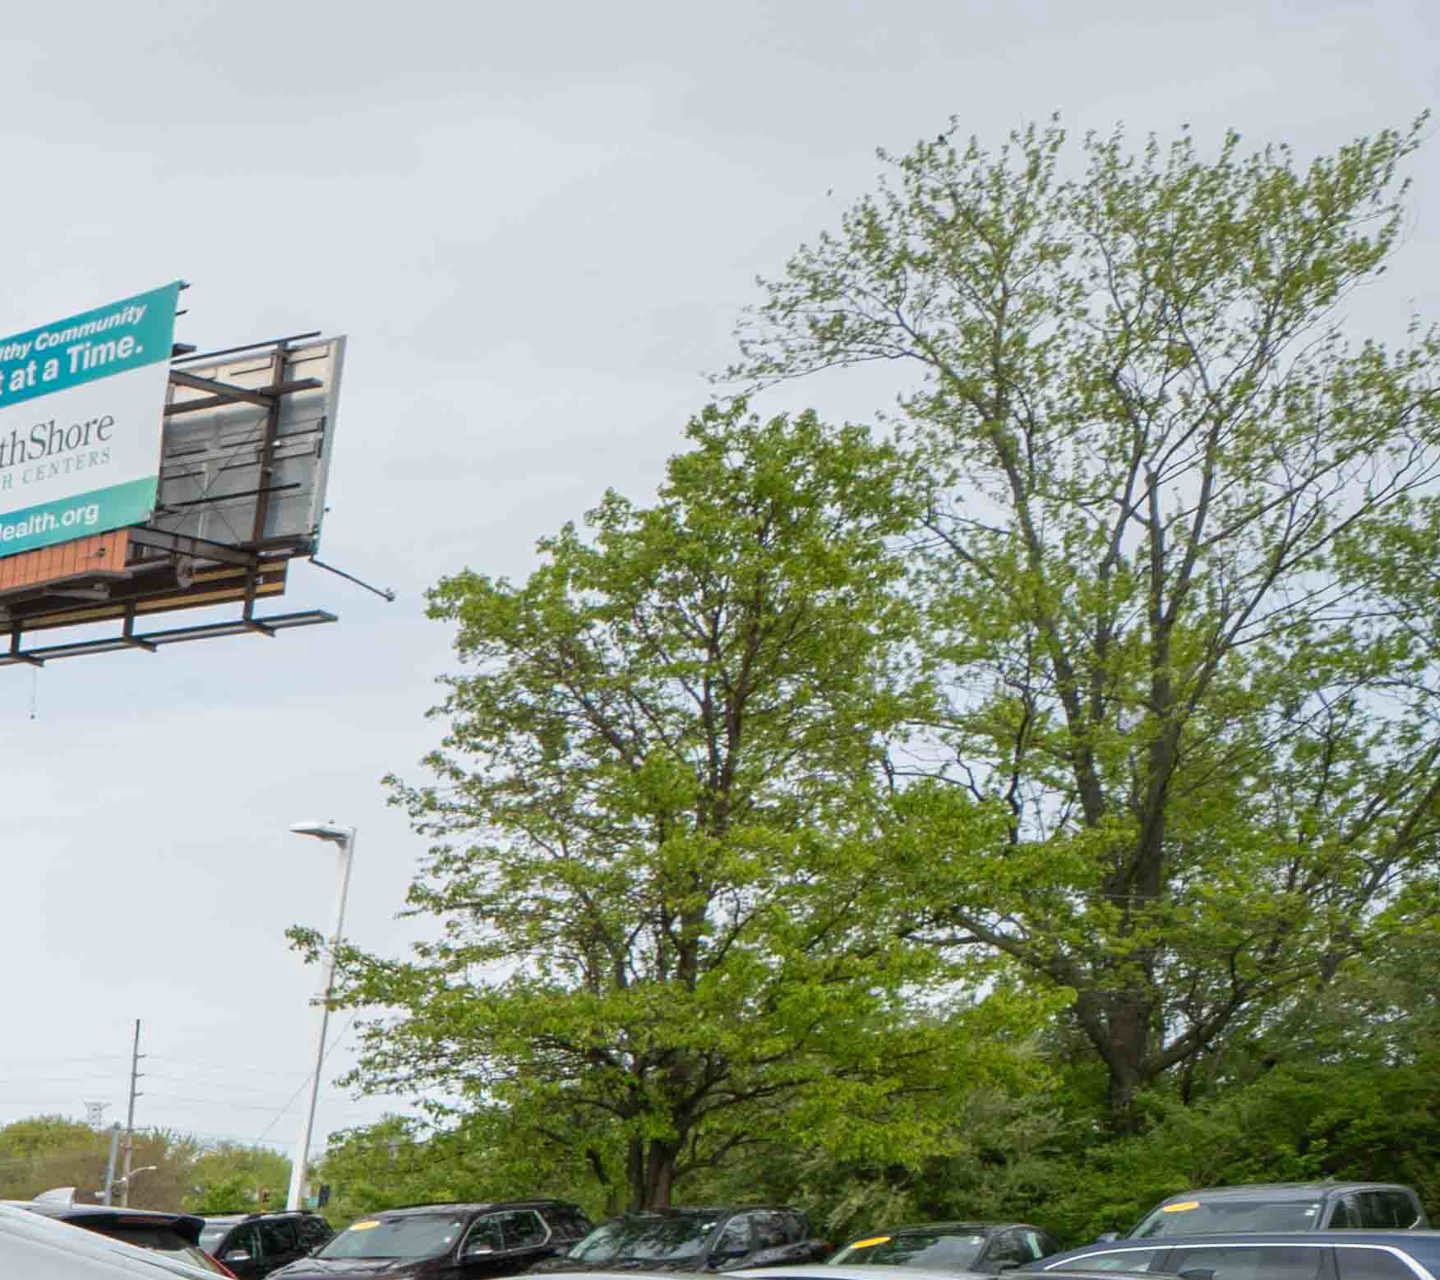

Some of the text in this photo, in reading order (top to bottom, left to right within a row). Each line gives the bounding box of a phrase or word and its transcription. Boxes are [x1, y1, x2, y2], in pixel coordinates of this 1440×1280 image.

[35, 304, 148, 351] Community
[9, 362, 37, 392] at
[43, 359, 59, 381] a
[67, 334, 144, 374] Time.
[22, 447, 111, 484] CENTERS
